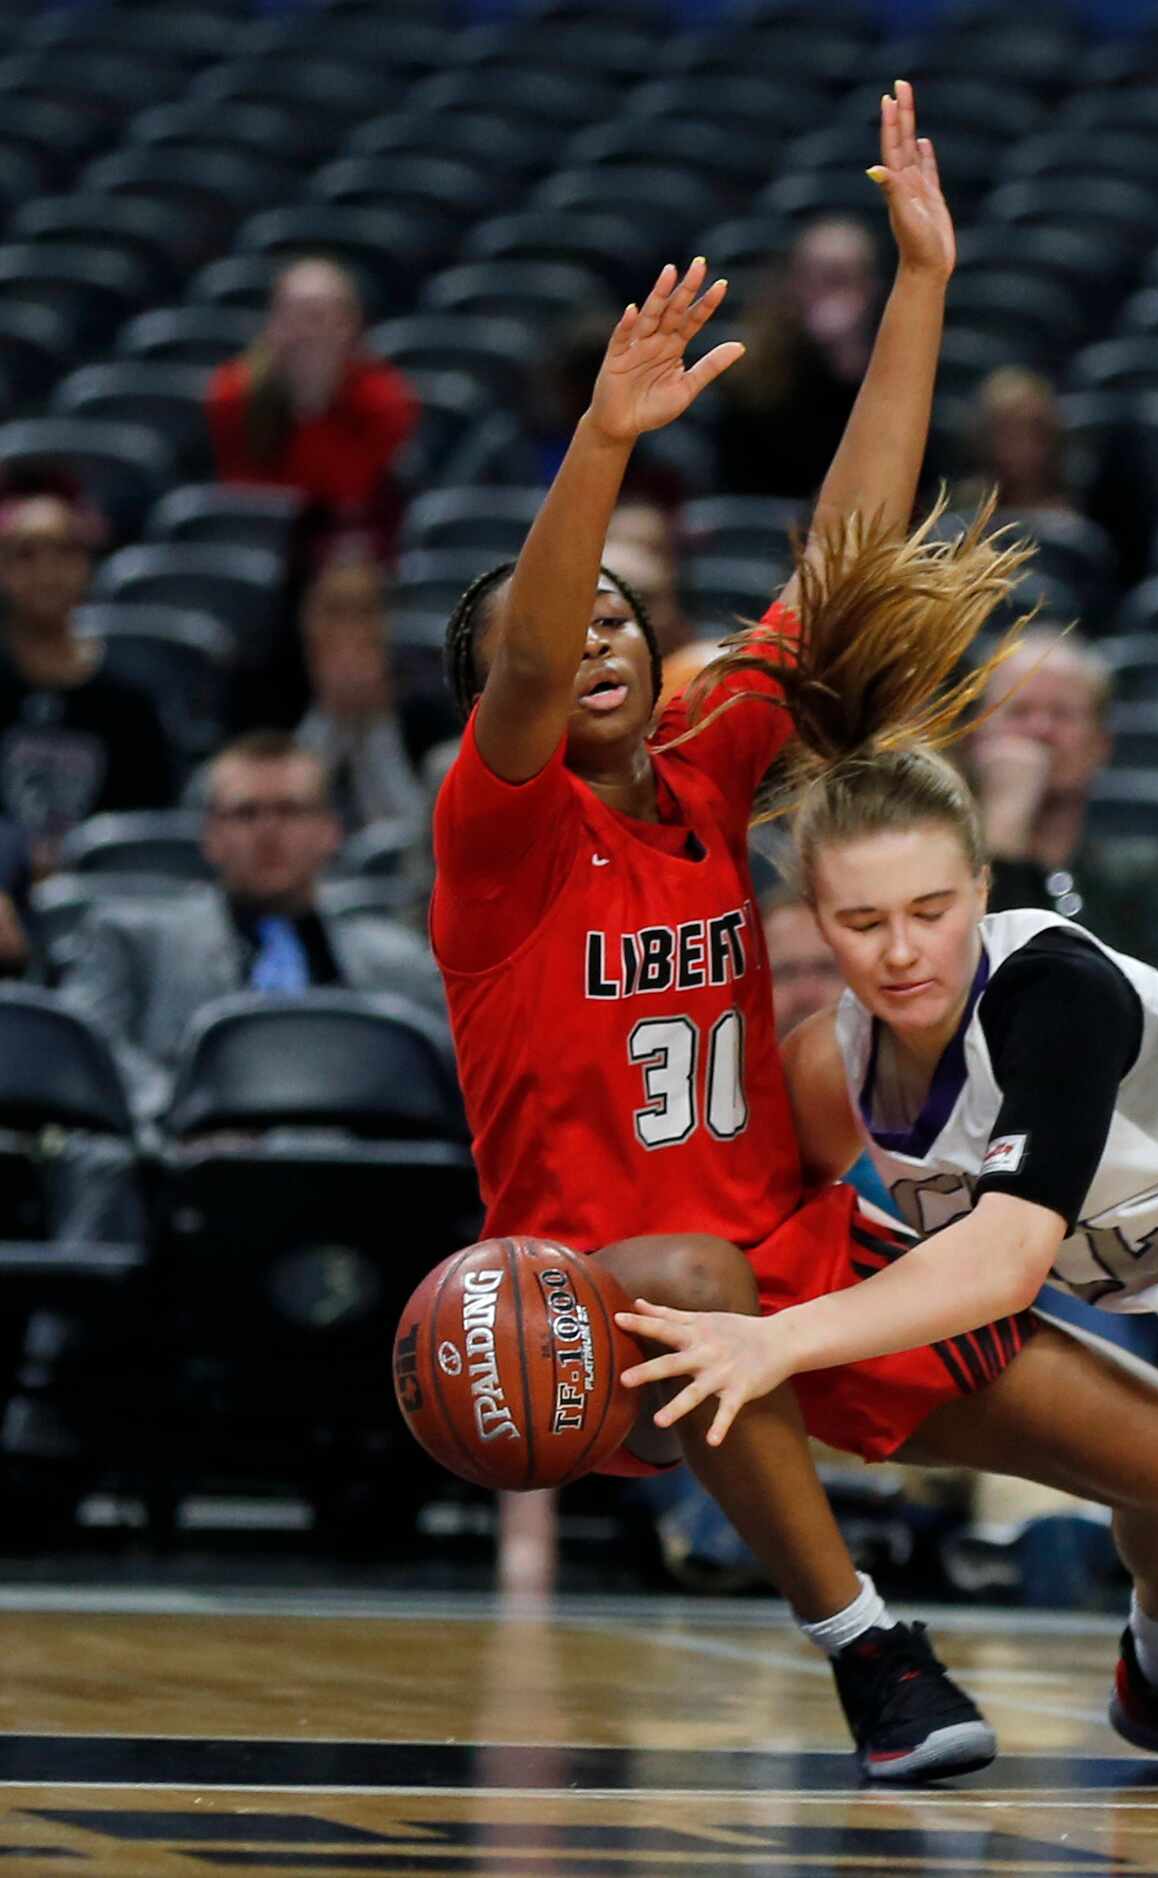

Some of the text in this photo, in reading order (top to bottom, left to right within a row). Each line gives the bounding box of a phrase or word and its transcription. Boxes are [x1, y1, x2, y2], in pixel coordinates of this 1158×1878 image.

[585, 899, 752, 999] LIBERT
[462, 1267, 520, 1442] SPALDING
[538, 1268, 586, 1436] TF-1000
